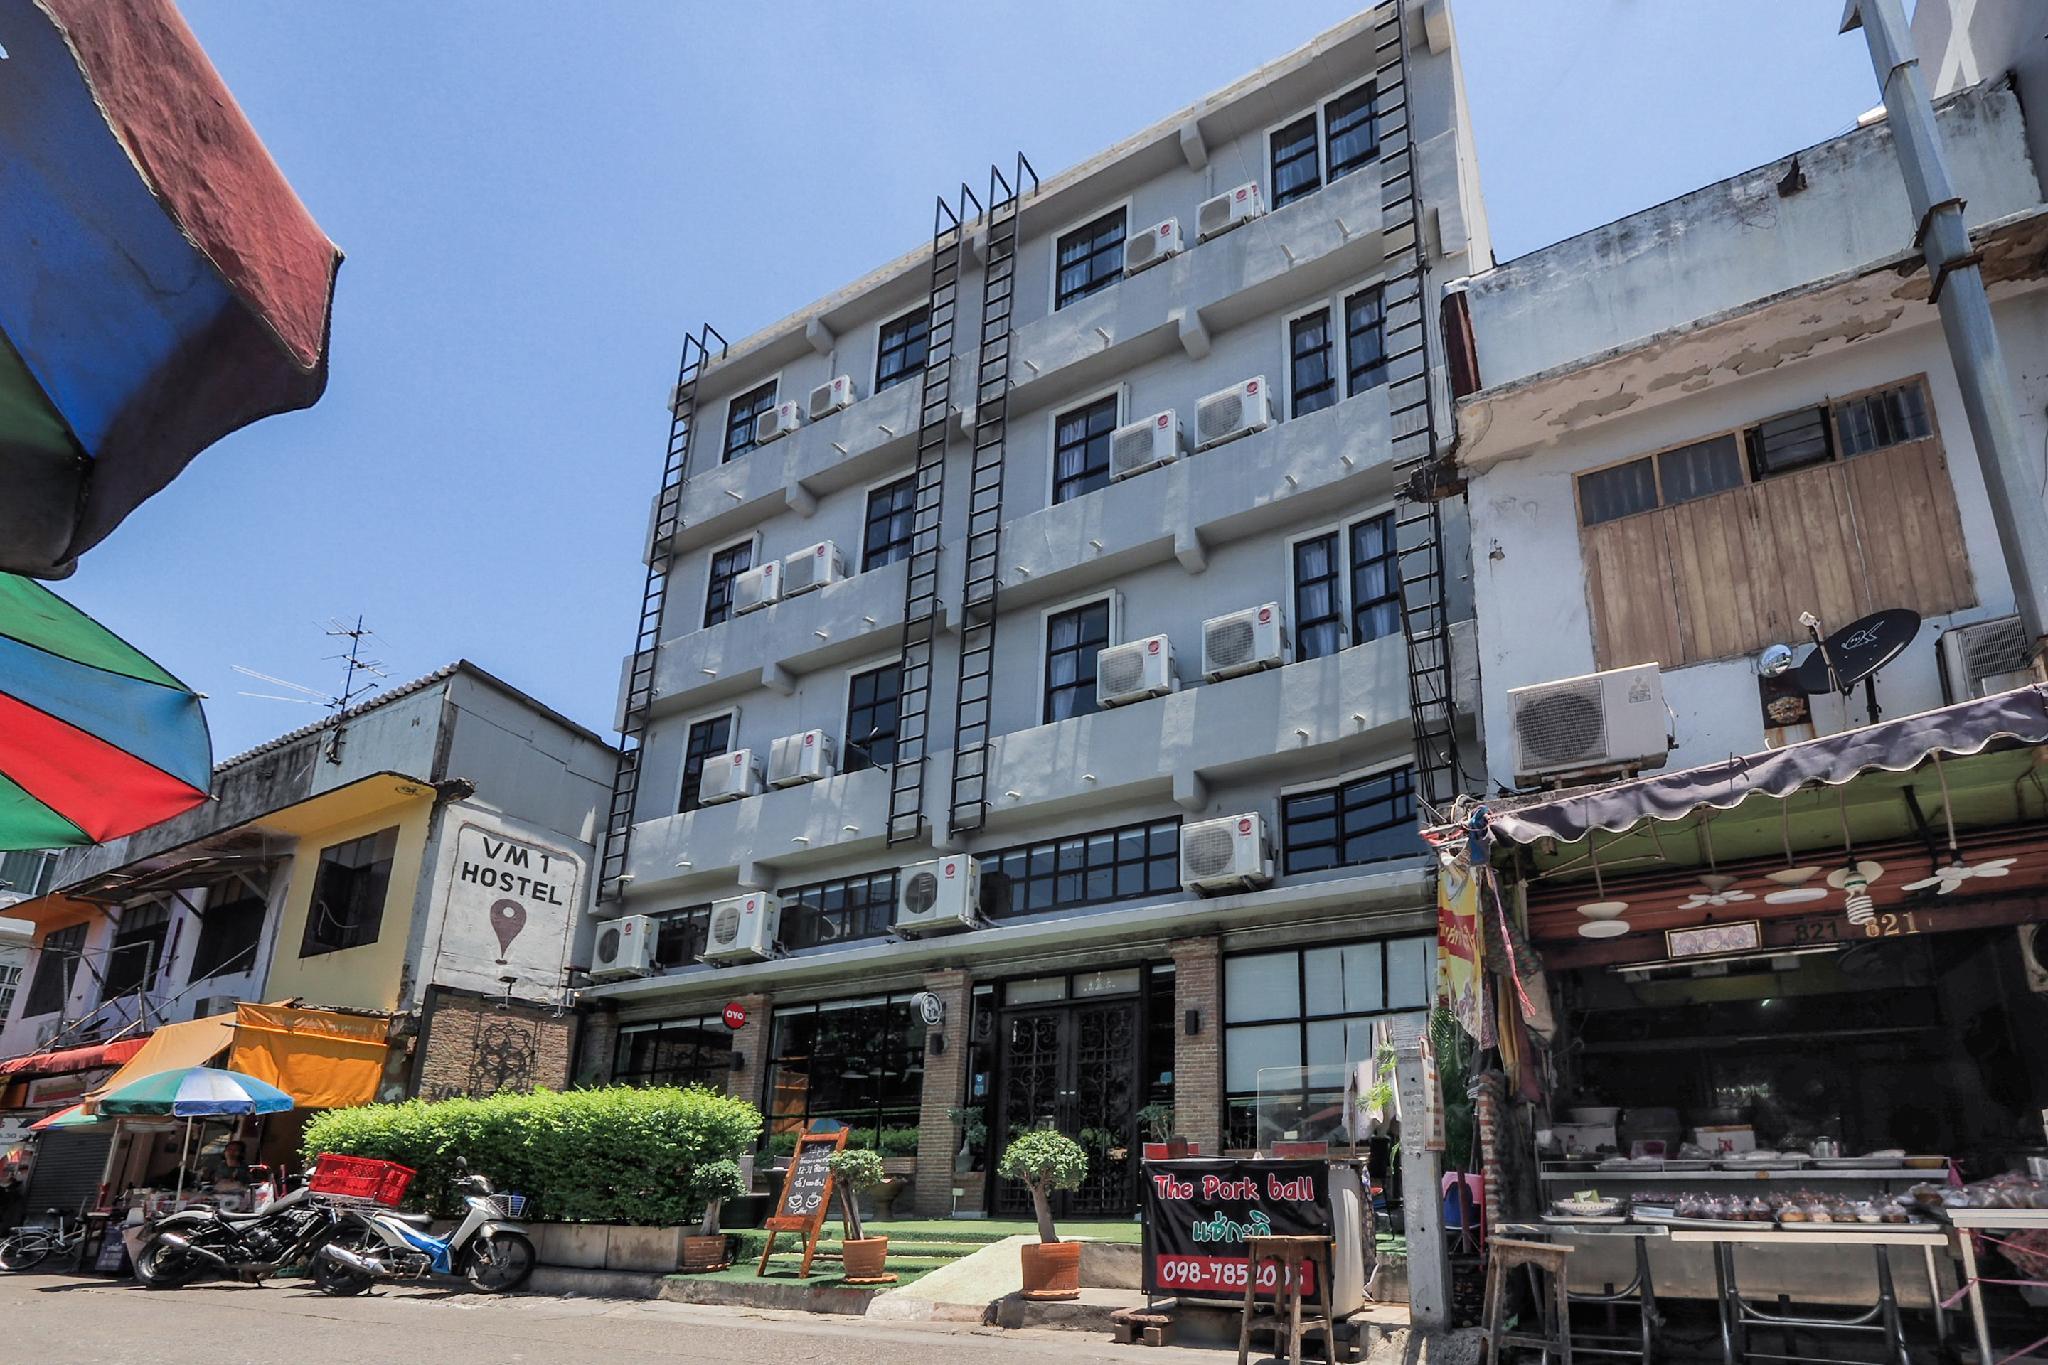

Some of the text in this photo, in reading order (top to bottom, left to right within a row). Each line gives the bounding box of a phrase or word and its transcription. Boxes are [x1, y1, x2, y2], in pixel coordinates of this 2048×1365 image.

[461, 862, 562, 906] HOSTEL
[1794, 921, 1840, 942] 821
[1864, 911, 1921, 938] 821
[1153, 1172, 1314, 1201] The Pork ball
